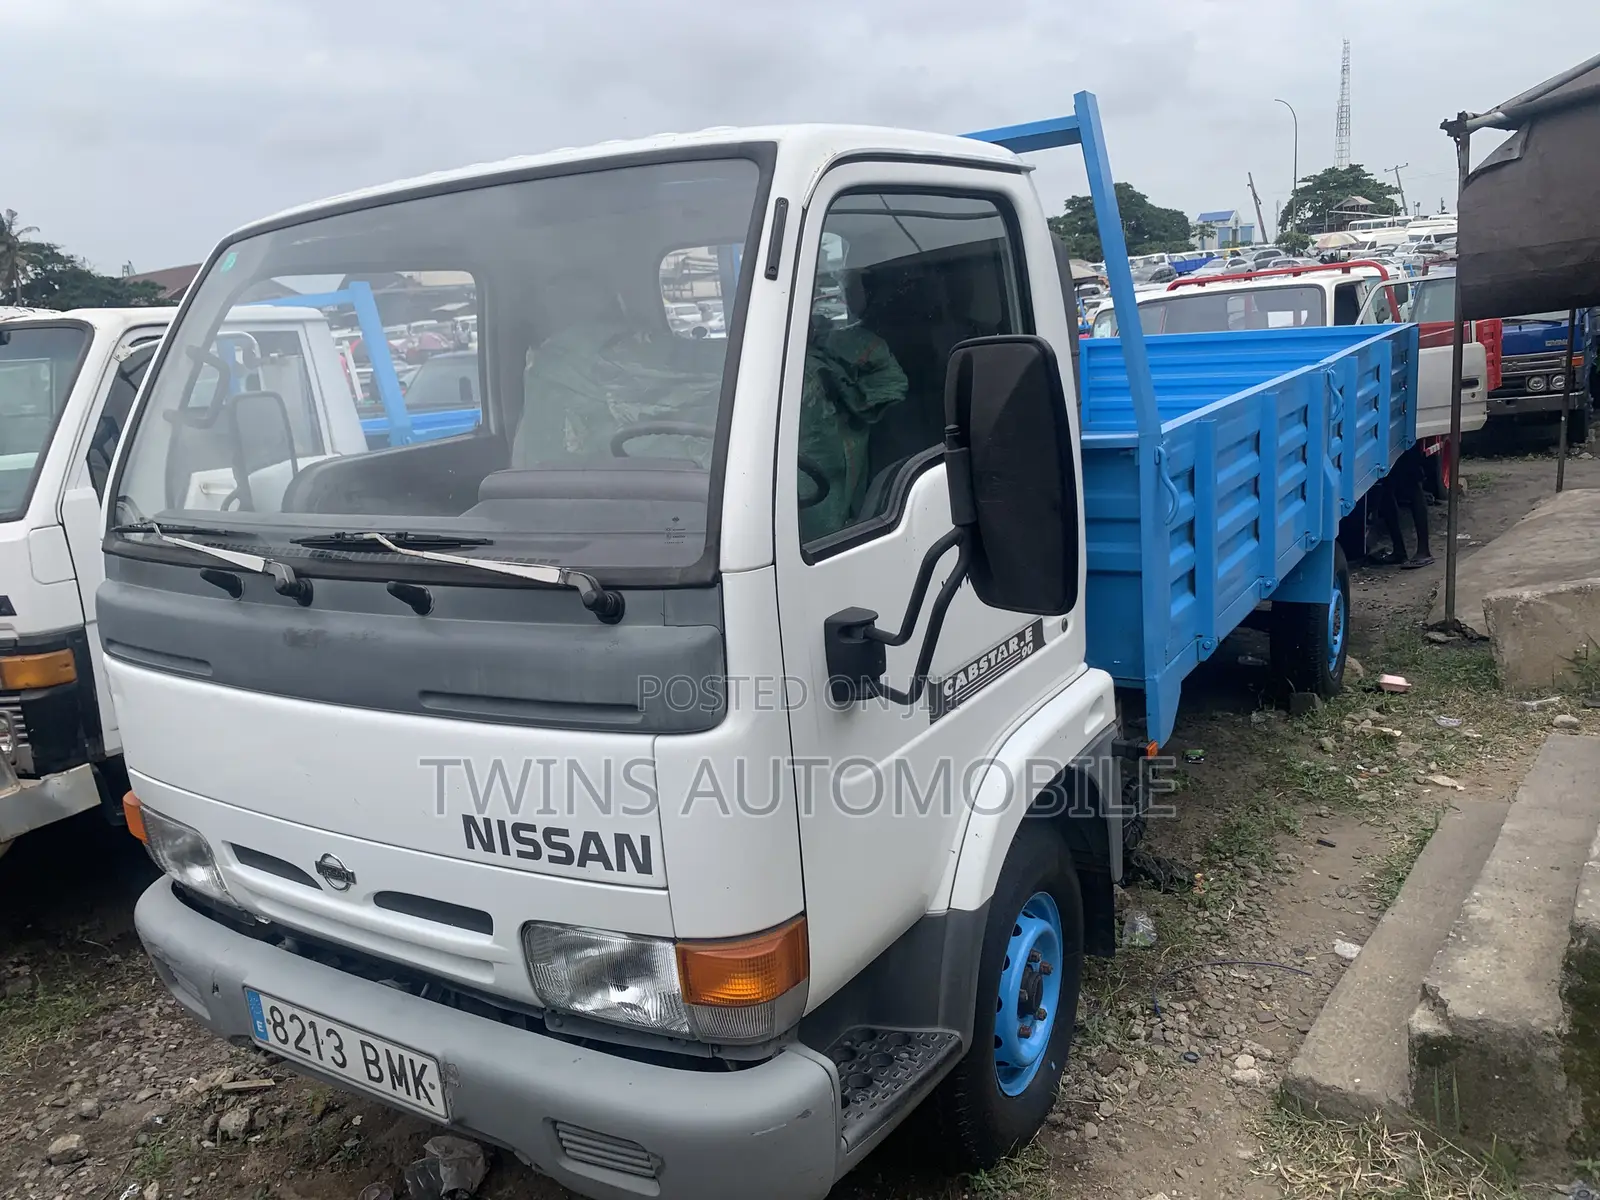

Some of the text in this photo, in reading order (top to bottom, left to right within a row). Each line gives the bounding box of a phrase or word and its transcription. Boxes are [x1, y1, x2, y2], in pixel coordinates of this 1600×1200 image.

[462, 814, 653, 875] NISSAN
[269, 1005, 435, 1107] 8213 BMK
